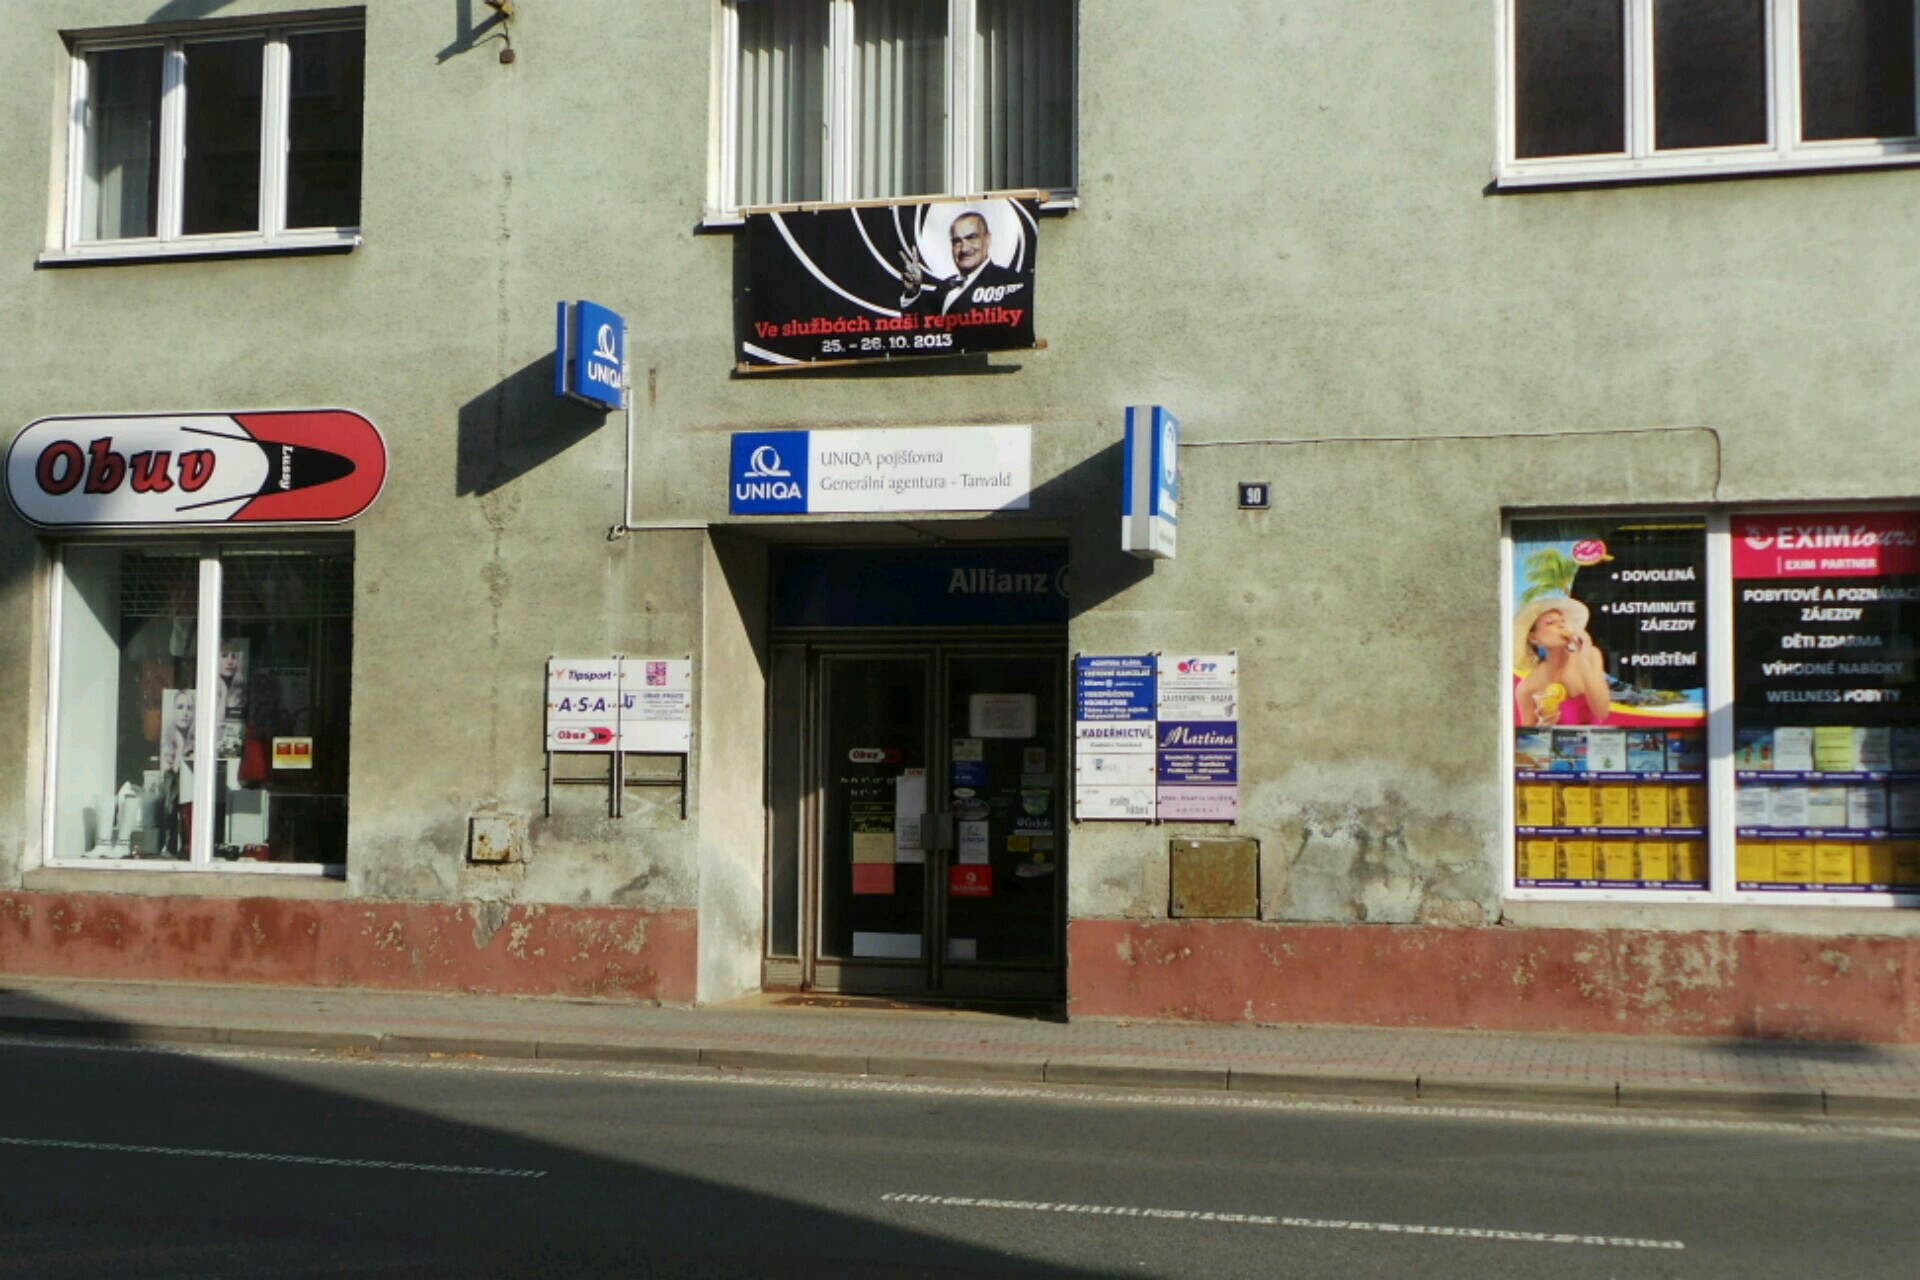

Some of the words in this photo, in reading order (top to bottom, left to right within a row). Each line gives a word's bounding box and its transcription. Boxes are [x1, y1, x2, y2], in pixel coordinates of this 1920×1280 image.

[754, 320, 779, 338] Ve
[781, 315, 870, 335] službách
[875, 311, 919, 331] naší
[923, 306, 1024, 330] republiky
[821, 339, 846, 353] 25.
[861, 337, 886, 350] 26.
[888, 335, 910, 348] 10.
[914, 333, 954, 347] 2013
[35, 436, 216, 496] Obuv
[279, 444, 294, 490] Lussy
[820, 450, 872, 466] UNIQA
[876, 449, 944, 470] pojišťovna
[735, 481, 803, 501] UNIQA
[820, 474, 885, 491] Generální
[888, 475, 946, 495] agentura
[959, 471, 1012, 488] Tanvald
[1784, 558, 1816, 571] EXIM
[1820, 557, 1877, 570] PARTNER
[947, 567, 1049, 594] Allianz
[1621, 566, 1696, 582] DOVOLENÁ
[1743, 585, 1820, 602] POBYTOVÉ
[1822, 587, 1834, 601] A
[1611, 601, 1696, 615] LASTMINUTE
[1801, 605, 1864, 622] ZÁJEZDY
[1640, 618, 1697, 632] ZÁJEZDY
[1781, 633, 1815, 649] DĚTI
[1818, 635, 1883, 649] ZDARMA
[1631, 651, 1697, 667] POJIŠTĚNÍ
[1762, 659, 1835, 676] VÝHODNÉ
[1838, 660, 1903, 675] NABÍDKY
[568, 669, 612, 683] Tipsport
[1766, 690, 1840, 702] WELLNESS
[1843, 688, 1901, 702] POBYTY
